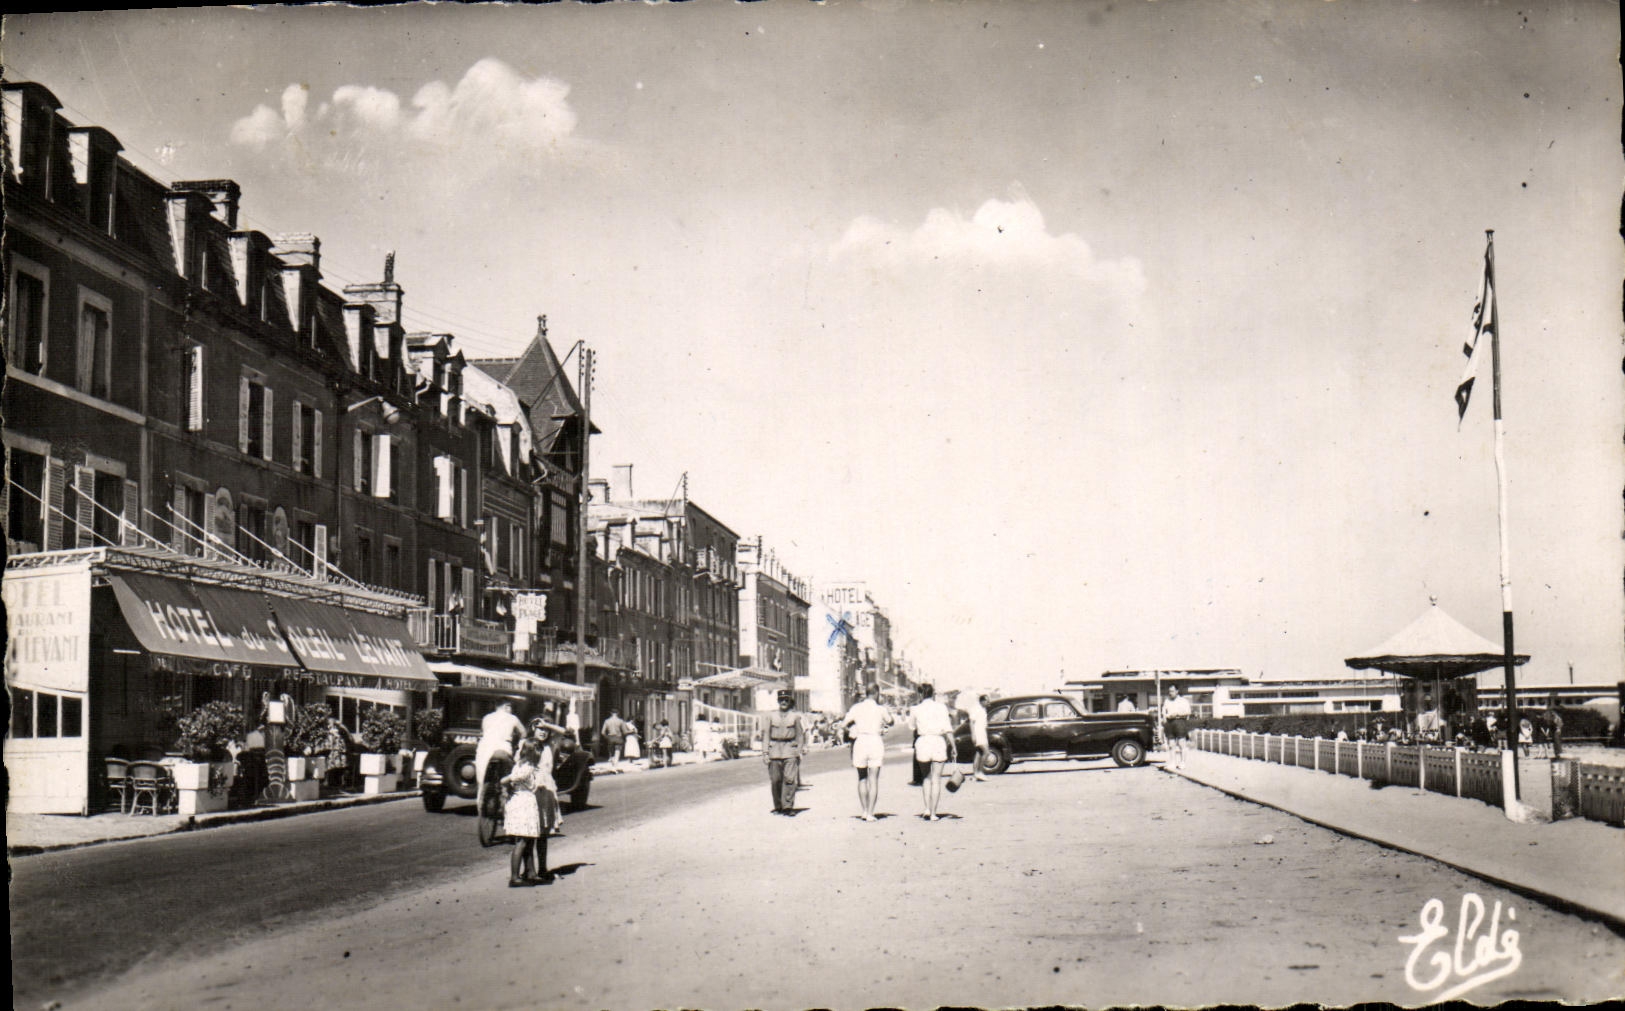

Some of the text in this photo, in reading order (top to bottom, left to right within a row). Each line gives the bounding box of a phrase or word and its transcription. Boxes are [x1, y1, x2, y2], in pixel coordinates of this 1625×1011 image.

[827, 588, 862, 603] HOTEL
[145, 600, 412, 667] HOTEL du SOLEIL LEVANT
[25, 636, 80, 663] LEVANT
